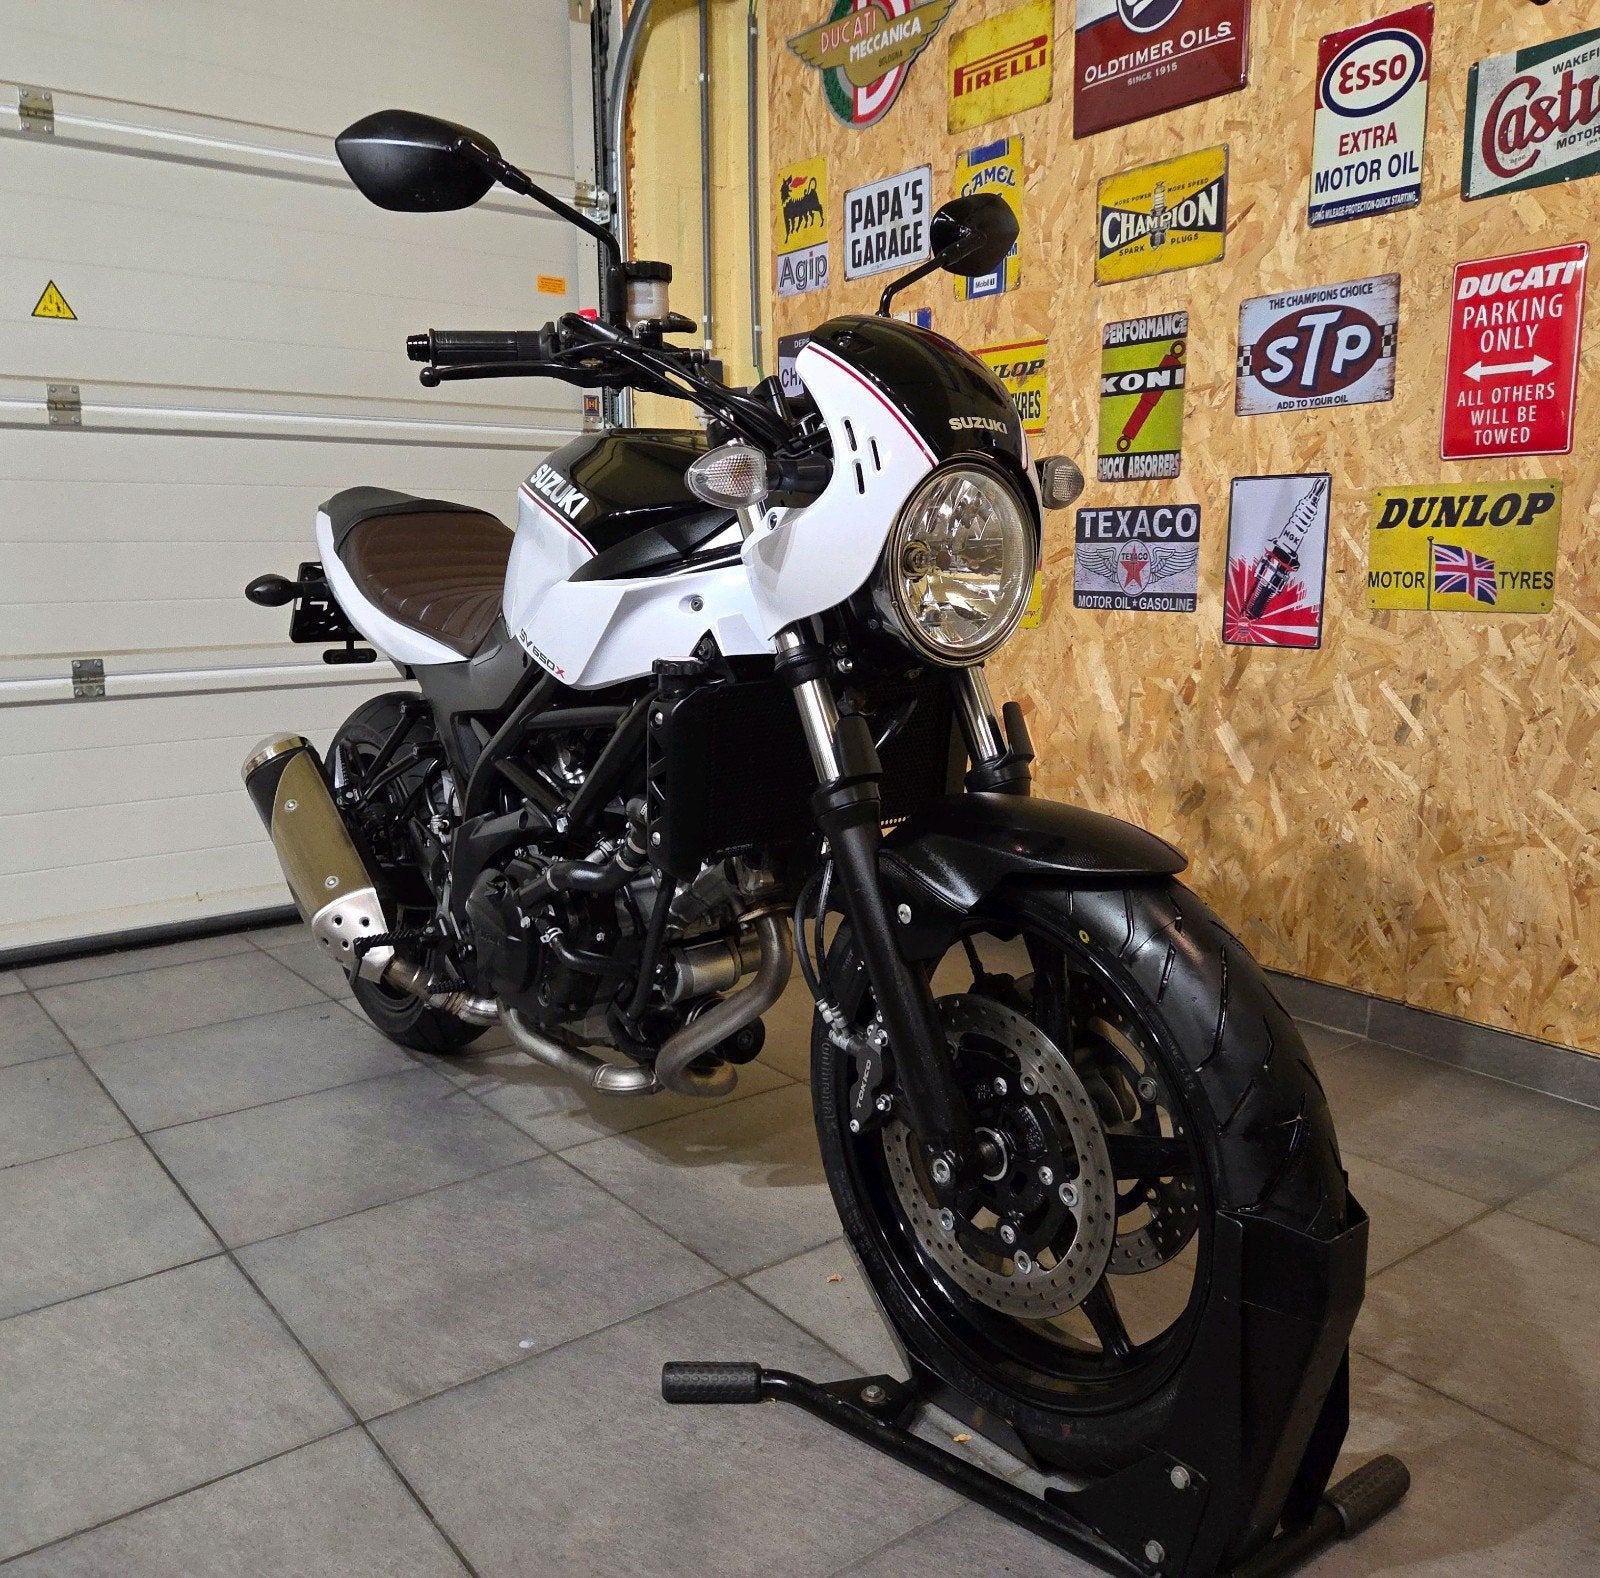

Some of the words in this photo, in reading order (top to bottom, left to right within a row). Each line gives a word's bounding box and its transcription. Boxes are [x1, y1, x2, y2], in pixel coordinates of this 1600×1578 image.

[821, 10, 877, 54] DUCATI
[850, 17, 922, 62] MECCANICA
[953, 34, 1048, 98] PIRELLI
[1085, 40, 1174, 83] OLDTIMER
[1180, 21, 1232, 49] OILS
[1552, 47, 1600, 75] WAKEFI
[1127, 72, 1152, 86] SINCE
[1155, 62, 1178, 77] 1915
[1338, 122, 1398, 157] EXTRA
[1481, 70, 1600, 178] Castr
[1556, 125, 1600, 150] MOTOR
[961, 165, 1016, 198] CAMEL
[1167, 184, 1185, 193] MORE
[1187, 178, 1209, 189] SPEED
[1315, 158, 1382, 195] MOTOR
[1387, 151, 1419, 178] OIL
[851, 179, 923, 233] PAPA'S
[1114, 198, 1131, 206] MORE
[1131, 193, 1152, 202] POWER
[1102, 183, 1219, 249] CHAMPION
[851, 220, 923, 269] GARAGE
[1119, 244, 1145, 257] SPARK
[1170, 233, 1199, 245] PLUGS
[780, 253, 828, 290] Agip
[1457, 260, 1579, 300] DUCATI
[1269, 299, 1285, 310] THE
[1286, 288, 1338, 308] CHAMPIONS
[1339, 283, 1373, 299] CHOICE
[1463, 293, 1563, 330] PARKING
[1103, 312, 1188, 345] PERFORMANCE
[1480, 323, 1539, 354] ONLY
[1261, 310, 1372, 386] STP
[1101, 368, 1185, 394] KONI
[1457, 391, 1484, 408] ALL
[1491, 382, 1555, 405] OTHERS
[1011, 389, 1041, 421] YRES
[1277, 400, 1295, 410] ADD
[1296, 399, 1307, 408] TO
[1310, 396, 1333, 406] YOUR
[1334, 395, 1348, 404] OIL
[1471, 408, 1509, 426] WILL
[1517, 405, 1537, 423] BE
[948, 416, 1008, 435] SUZUKI
[1474, 426, 1530, 446] TOWED
[1097, 457, 1125, 480] SHOCK
[1128, 453, 1180, 478] ABSORBERS
[530, 463, 590, 519] SUZUKI
[1080, 508, 1198, 538] TEXACO
[1376, 492, 1556, 529] DUNLOP
[1283, 530, 1300, 545] NGK
[1122, 552, 1148, 561] TEXACO
[1368, 571, 1425, 589] MOTOR
[1499, 571, 1554, 590] TYRES
[1078, 595, 1112, 609] MOTOR
[1114, 597, 1131, 610] OIL
[1138, 597, 1194, 611] GASOLINE
[856, 1059, 872, 1109] TOKICO
